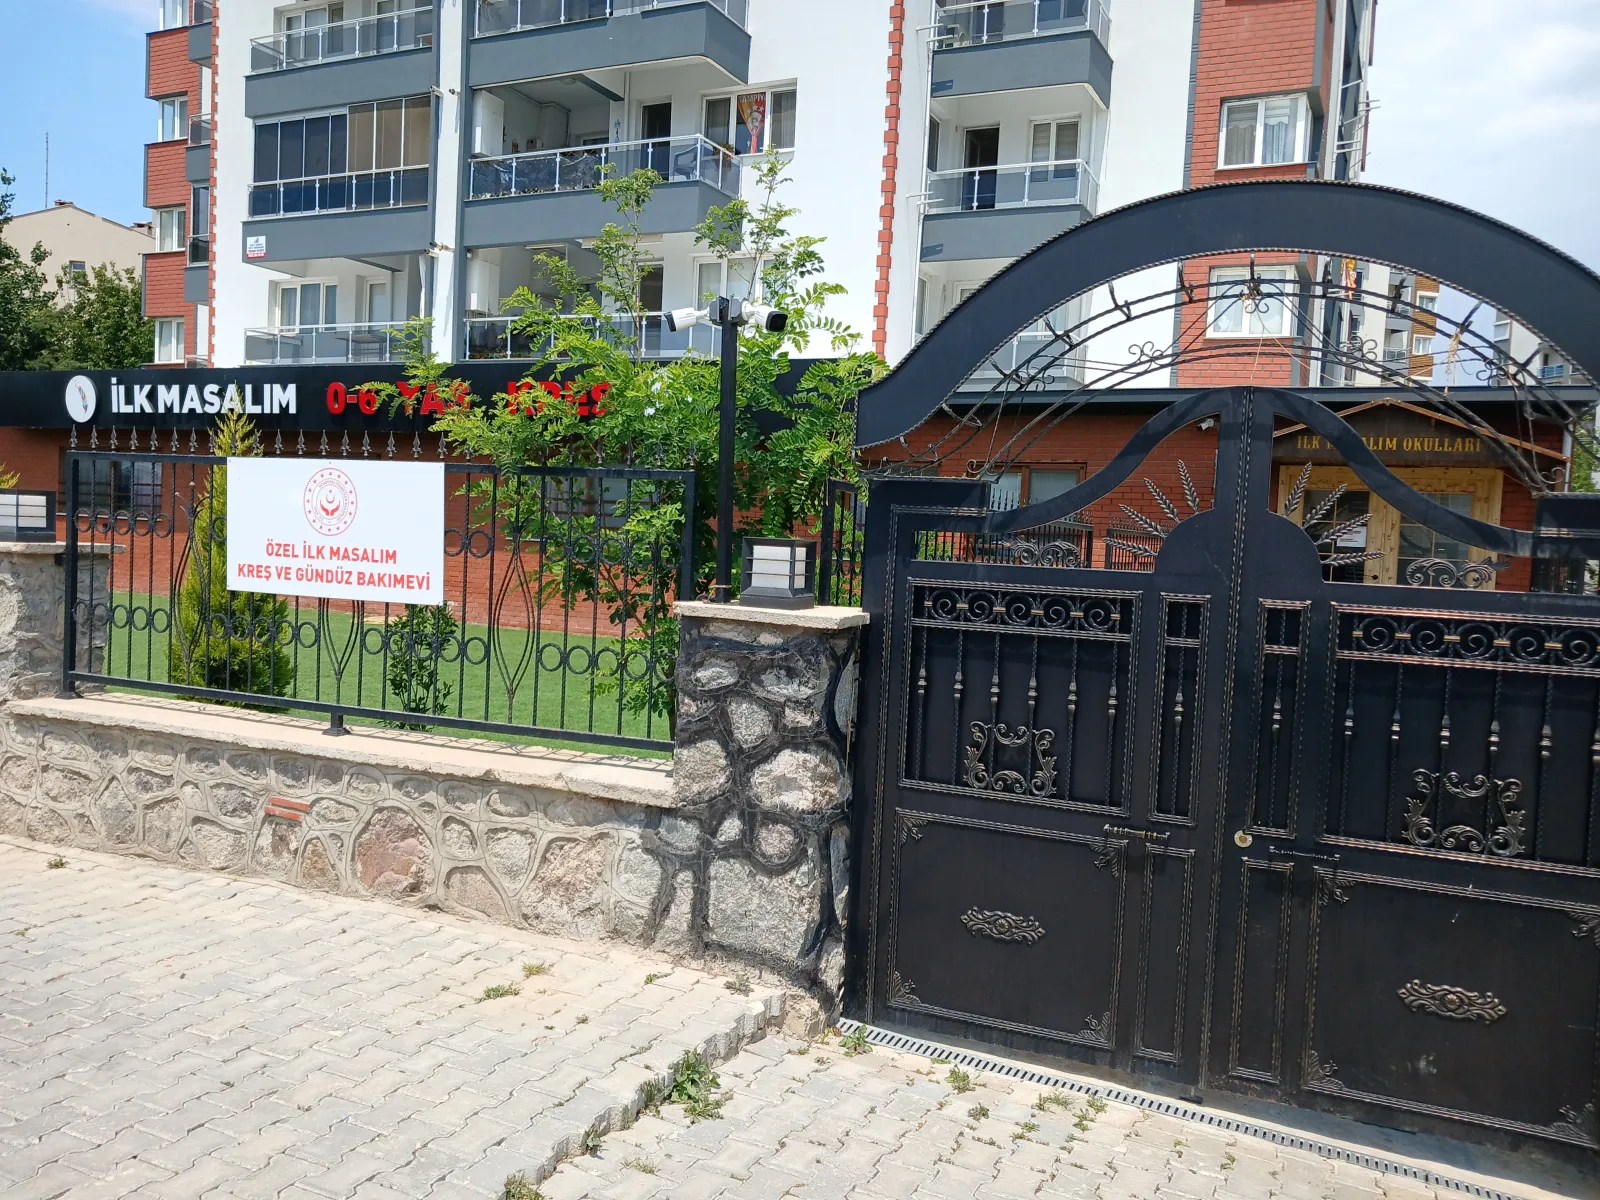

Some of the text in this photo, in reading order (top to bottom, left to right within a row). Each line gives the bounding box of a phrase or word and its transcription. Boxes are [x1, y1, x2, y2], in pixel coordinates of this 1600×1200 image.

[111, 377, 297, 414] İLK MASALIM
[327, 381, 378, 415] 0-6
[1403, 436, 1481, 452] OKULLARI
[265, 538, 397, 565] ÖZEL İLK MASALIM
[237, 563, 430, 591] KREŞ VE GÜNDÜZ BAKIMEVİ
